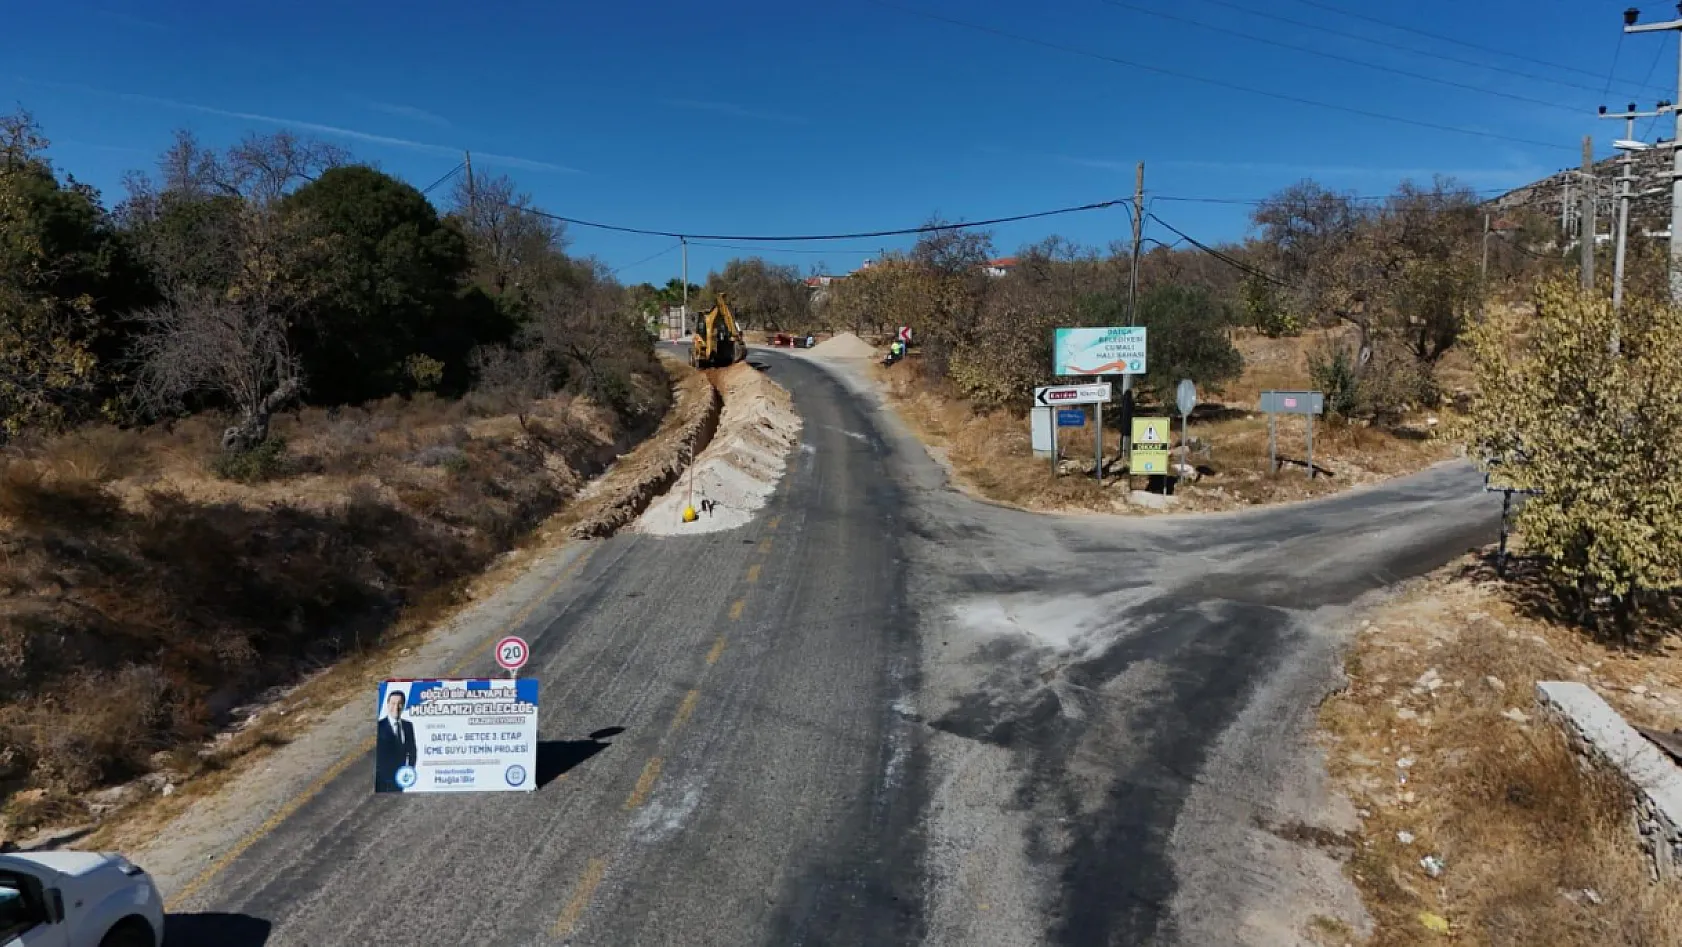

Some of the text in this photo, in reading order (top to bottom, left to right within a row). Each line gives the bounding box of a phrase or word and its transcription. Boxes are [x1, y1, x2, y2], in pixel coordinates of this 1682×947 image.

[503, 645, 521, 659] 20
[431, 733, 457, 742] DATÇA
[501, 732, 522, 741] ETAP
[469, 743, 493, 754] TEMİN
[494, 744, 529, 753] PROJESİ
